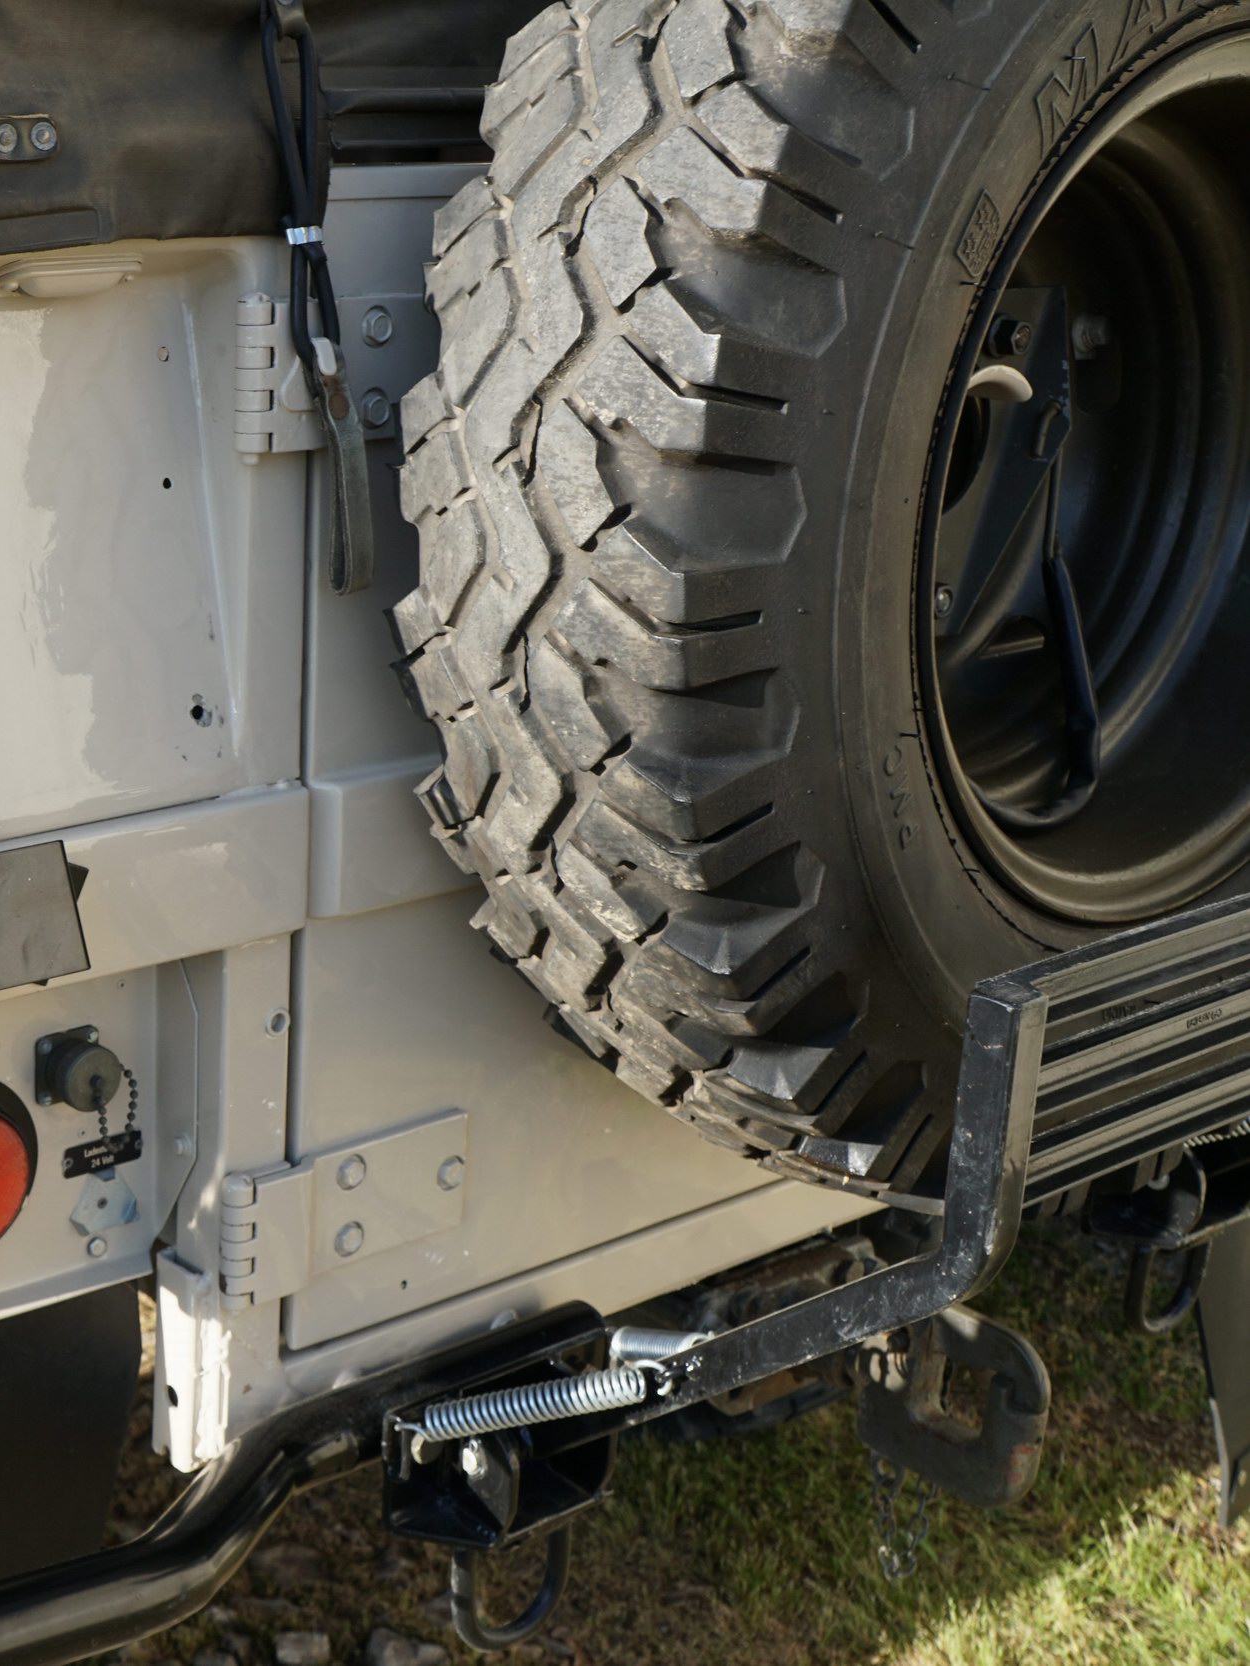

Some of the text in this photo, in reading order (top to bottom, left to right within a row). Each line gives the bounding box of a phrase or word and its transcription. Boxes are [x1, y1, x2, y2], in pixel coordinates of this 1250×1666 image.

[1035, 0, 1197, 161] MA
[91, 1154, 115, 1168] 24 Volt
